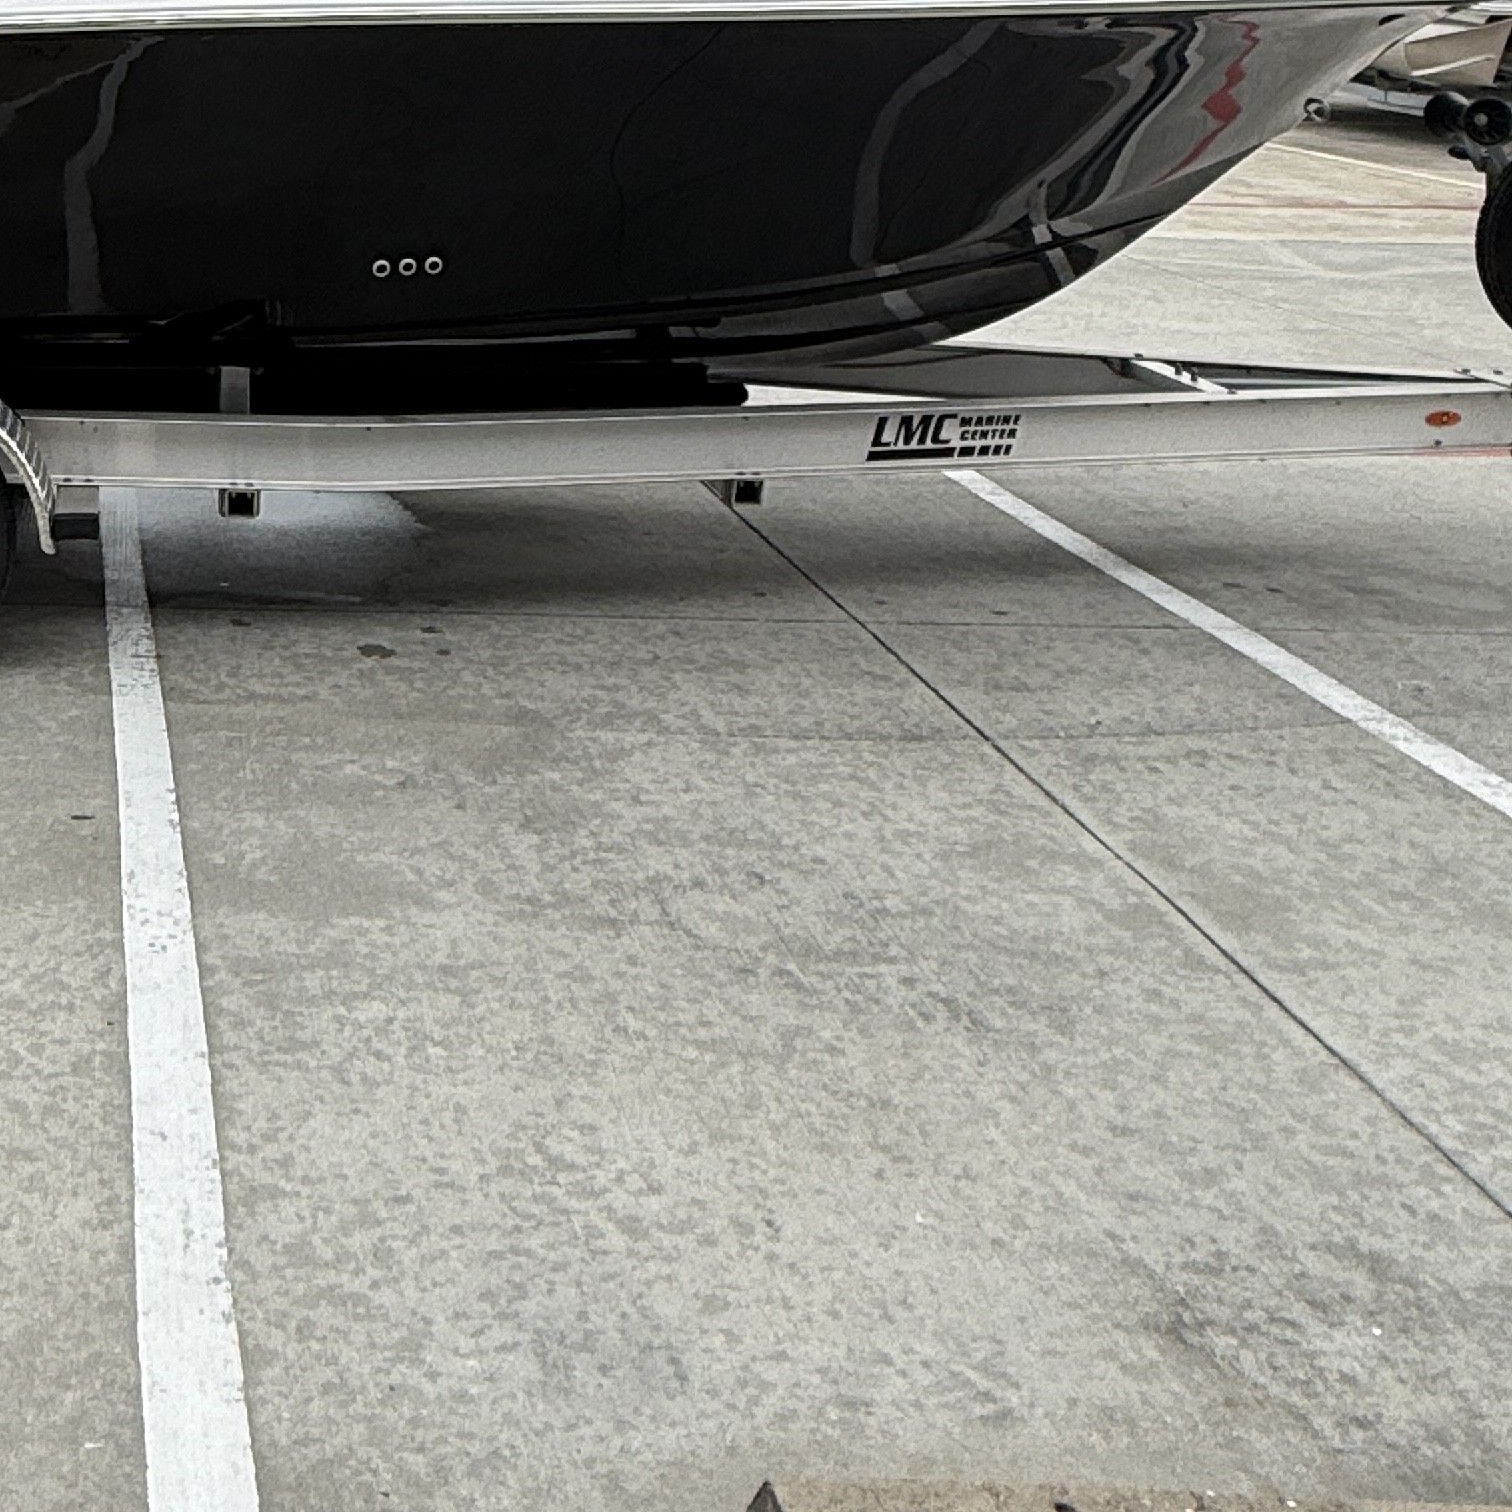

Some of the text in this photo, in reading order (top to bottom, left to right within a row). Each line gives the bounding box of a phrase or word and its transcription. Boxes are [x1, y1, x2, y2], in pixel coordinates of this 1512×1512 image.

[959, 414, 1022, 428] MARINE
[870, 413, 958, 448] LMC
[960, 428, 1018, 441] CENTER
